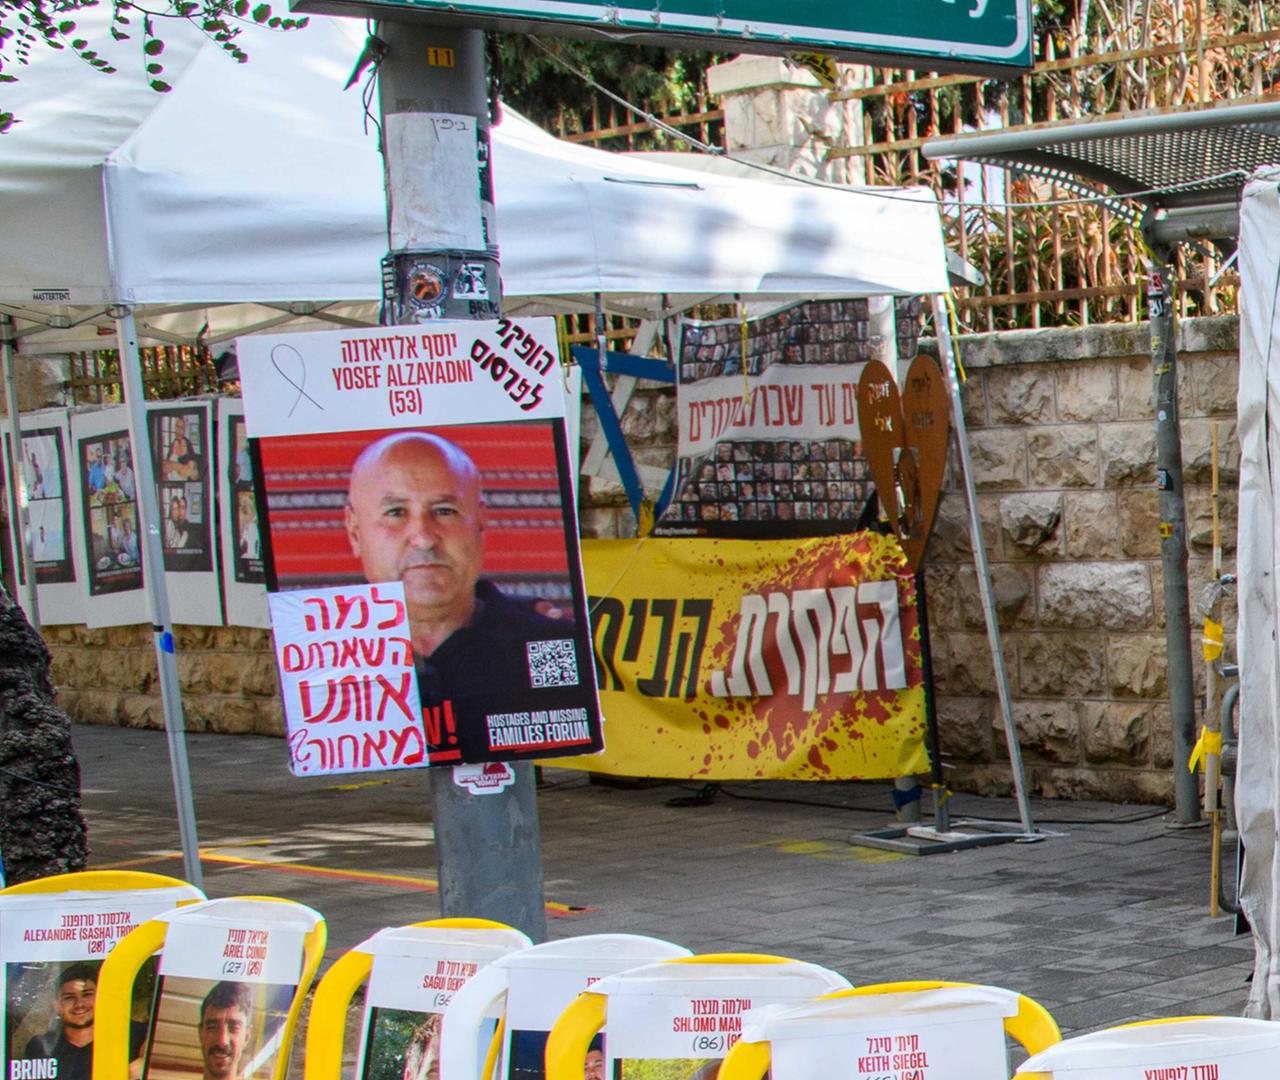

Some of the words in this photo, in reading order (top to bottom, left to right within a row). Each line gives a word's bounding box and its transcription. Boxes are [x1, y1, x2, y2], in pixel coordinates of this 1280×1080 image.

[432, 50, 452, 65] 11
[33, 292, 70, 300] MASTERTENT
[340, 336, 417, 362] אלזיאדנה
[421, 333, 458, 359] יוסף
[333, 363, 382, 391] YOSEF
[386, 359, 473, 388] ALZAYADNI
[470, 338, 544, 412] לפרסום
[389, 391, 424, 416] (53)
[305, 587, 406, 633] למה
[282, 636, 414, 673] השארתם
[298, 672, 415, 723] אותנו
[487, 713, 530, 730] HOSTAGES
[531, 711, 549, 726] AND
[550, 707, 587, 724] MISSING
[489, 727, 544, 748] FAMILIES
[546, 722, 591, 743] FORUM
[290, 726, 426, 771] מאחור?
[24, 927, 77, 942] ALEXANDRE
[79, 924, 114, 941] (SASHA)
[227, 929, 247, 946] קוניו
[249, 928, 269, 944] אריאל
[88, 940, 106, 955] (28)
[223, 944, 244, 959] ARIEL
[246, 945, 268, 960] CUNIO
[11, 1058, 58, 1080] BRING
[858, 1055, 891, 1074] KEITH
[892, 1052, 930, 1072] SIEGEL
